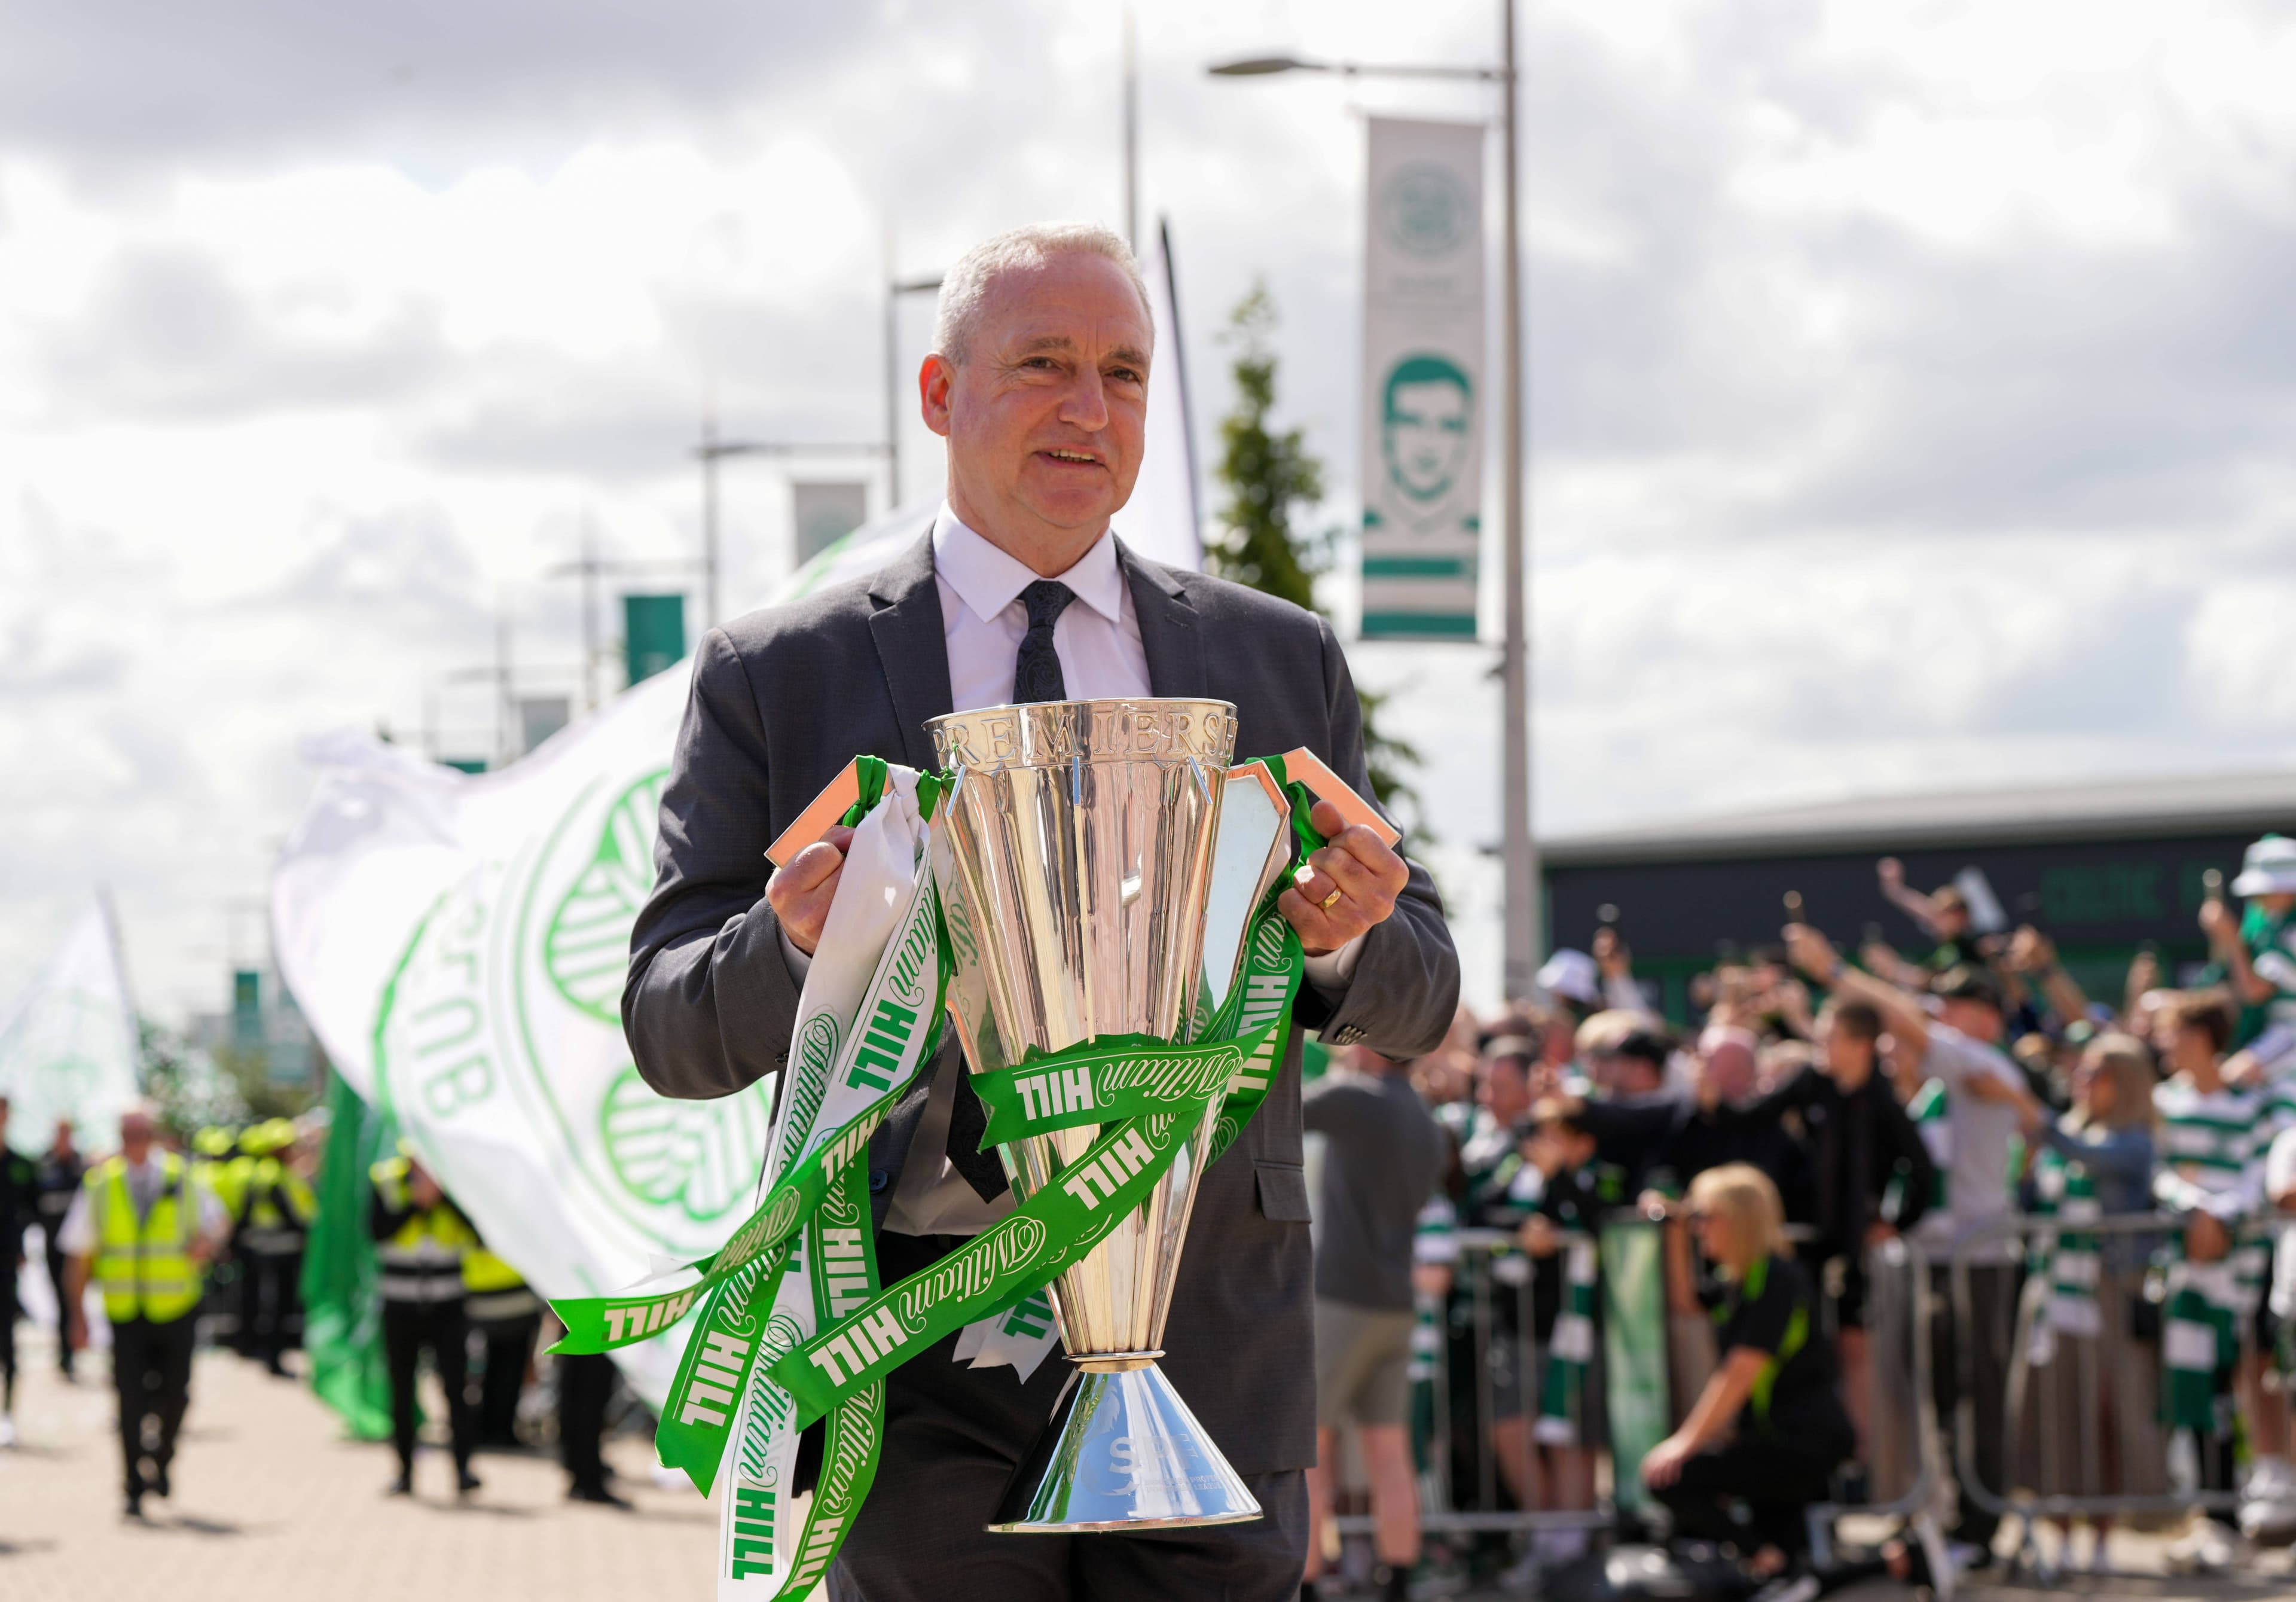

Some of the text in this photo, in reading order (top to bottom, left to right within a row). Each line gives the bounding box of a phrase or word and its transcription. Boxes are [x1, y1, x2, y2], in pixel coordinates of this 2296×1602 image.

[845, 867, 936, 1093] illiam HILL
[1014, 1046, 1244, 1121] William HILL
[1227, 1020, 1280, 1094] ILL
[820, 1109, 880, 1186] HILL
[1062, 1127, 1155, 1211] HILL
[706, 1185, 801, 1277] Willia
[822, 1228, 871, 1319] HILL
[899, 1216, 1046, 1334] William
[604, 1290, 694, 1342] HILL
[680, 1240, 786, 1427] lliam HILL
[808, 1305, 908, 1387] HILL
[732, 1487, 775, 1580] HILL
[781, 1516, 844, 1597] HILL
